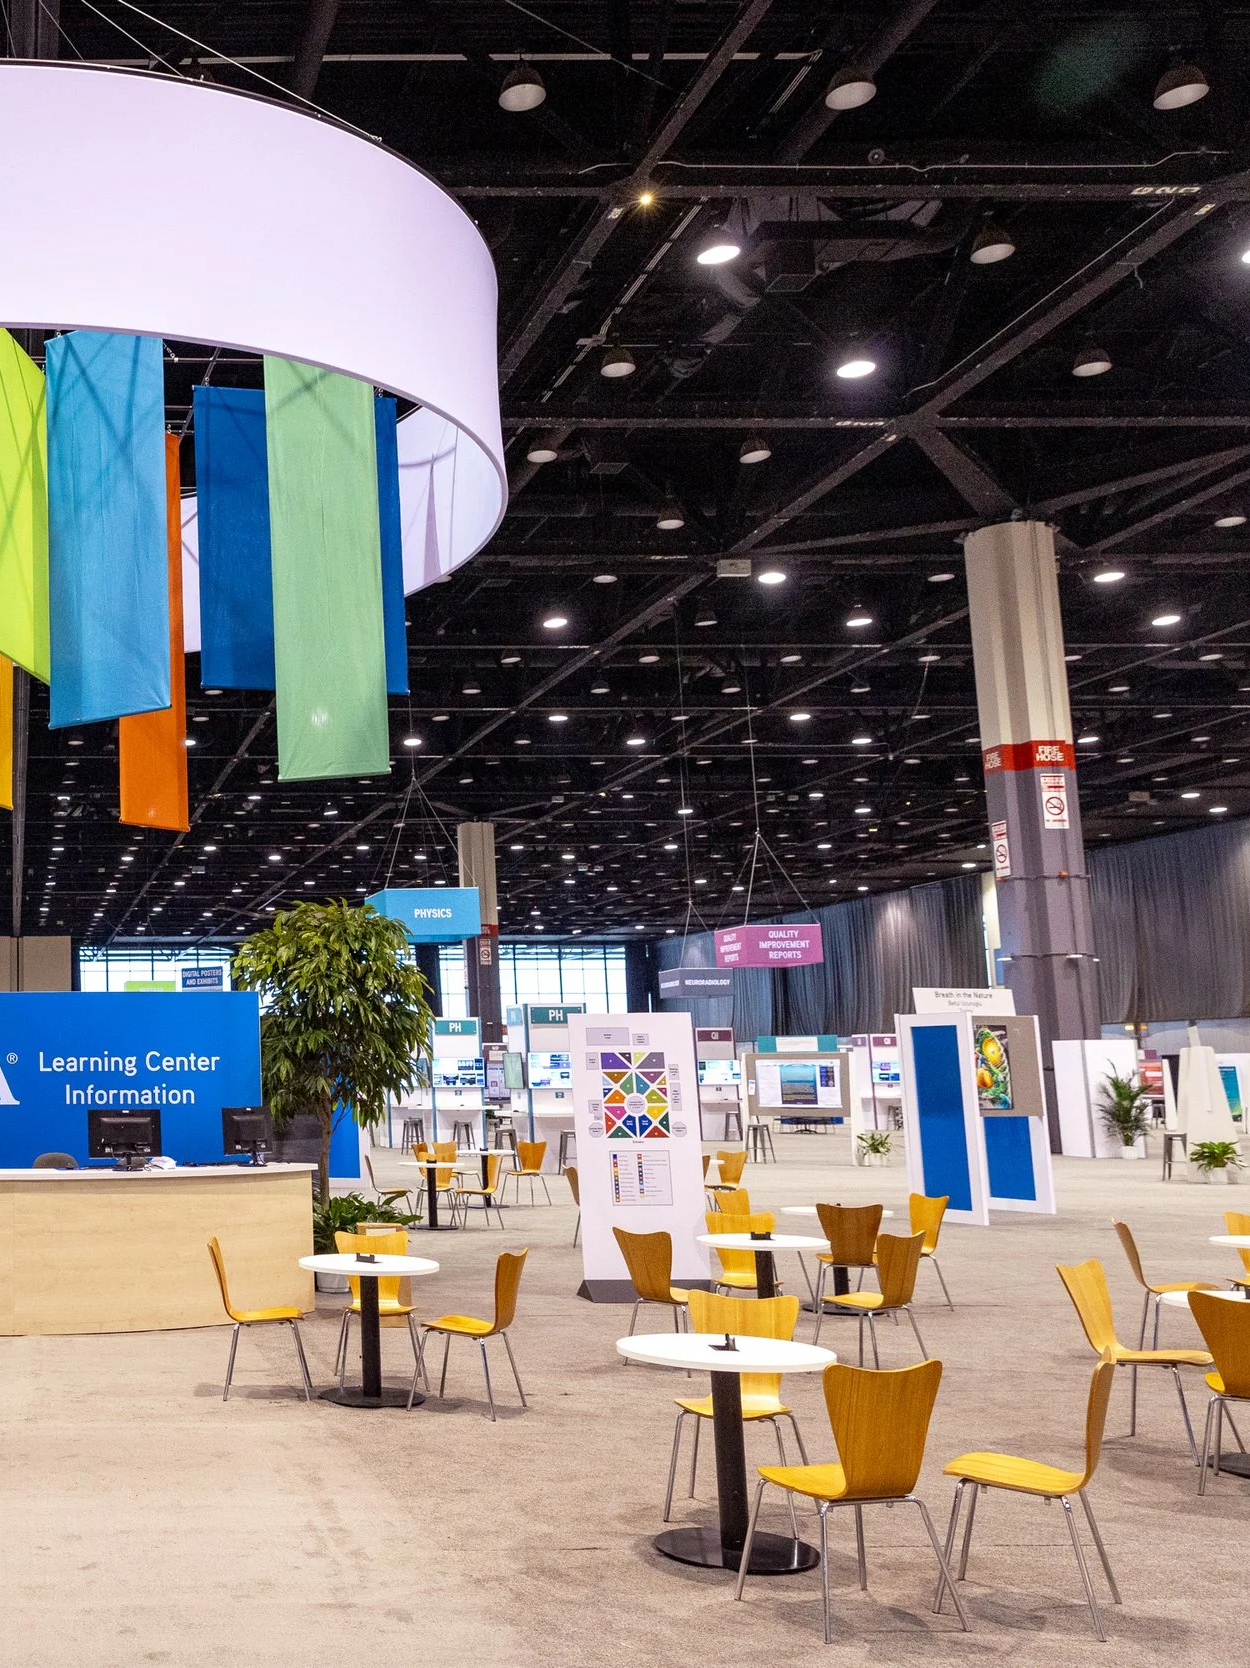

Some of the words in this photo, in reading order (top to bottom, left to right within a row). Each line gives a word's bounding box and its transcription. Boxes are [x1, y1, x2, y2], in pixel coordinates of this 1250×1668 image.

[1038, 745, 1059, 753] FIRE
[1036, 752, 1064, 762] HOSE
[414, 908, 452, 918] PHYSICS
[768, 930, 799, 939] QUALITY
[759, 940, 810, 949] IMPROVEMENT
[768, 951, 802, 960] REPORTS
[182, 970, 200, 978] DIGITAL
[201, 969, 222, 977] POSTERS
[197, 977, 218, 985] EXHIBITS
[548, 1009, 563, 1021] PH
[449, 1022, 461, 1032] PH
[38, 1050, 138, 1077] Learning
[145, 1051, 220, 1072] Center
[65, 1083, 196, 1105] Information
